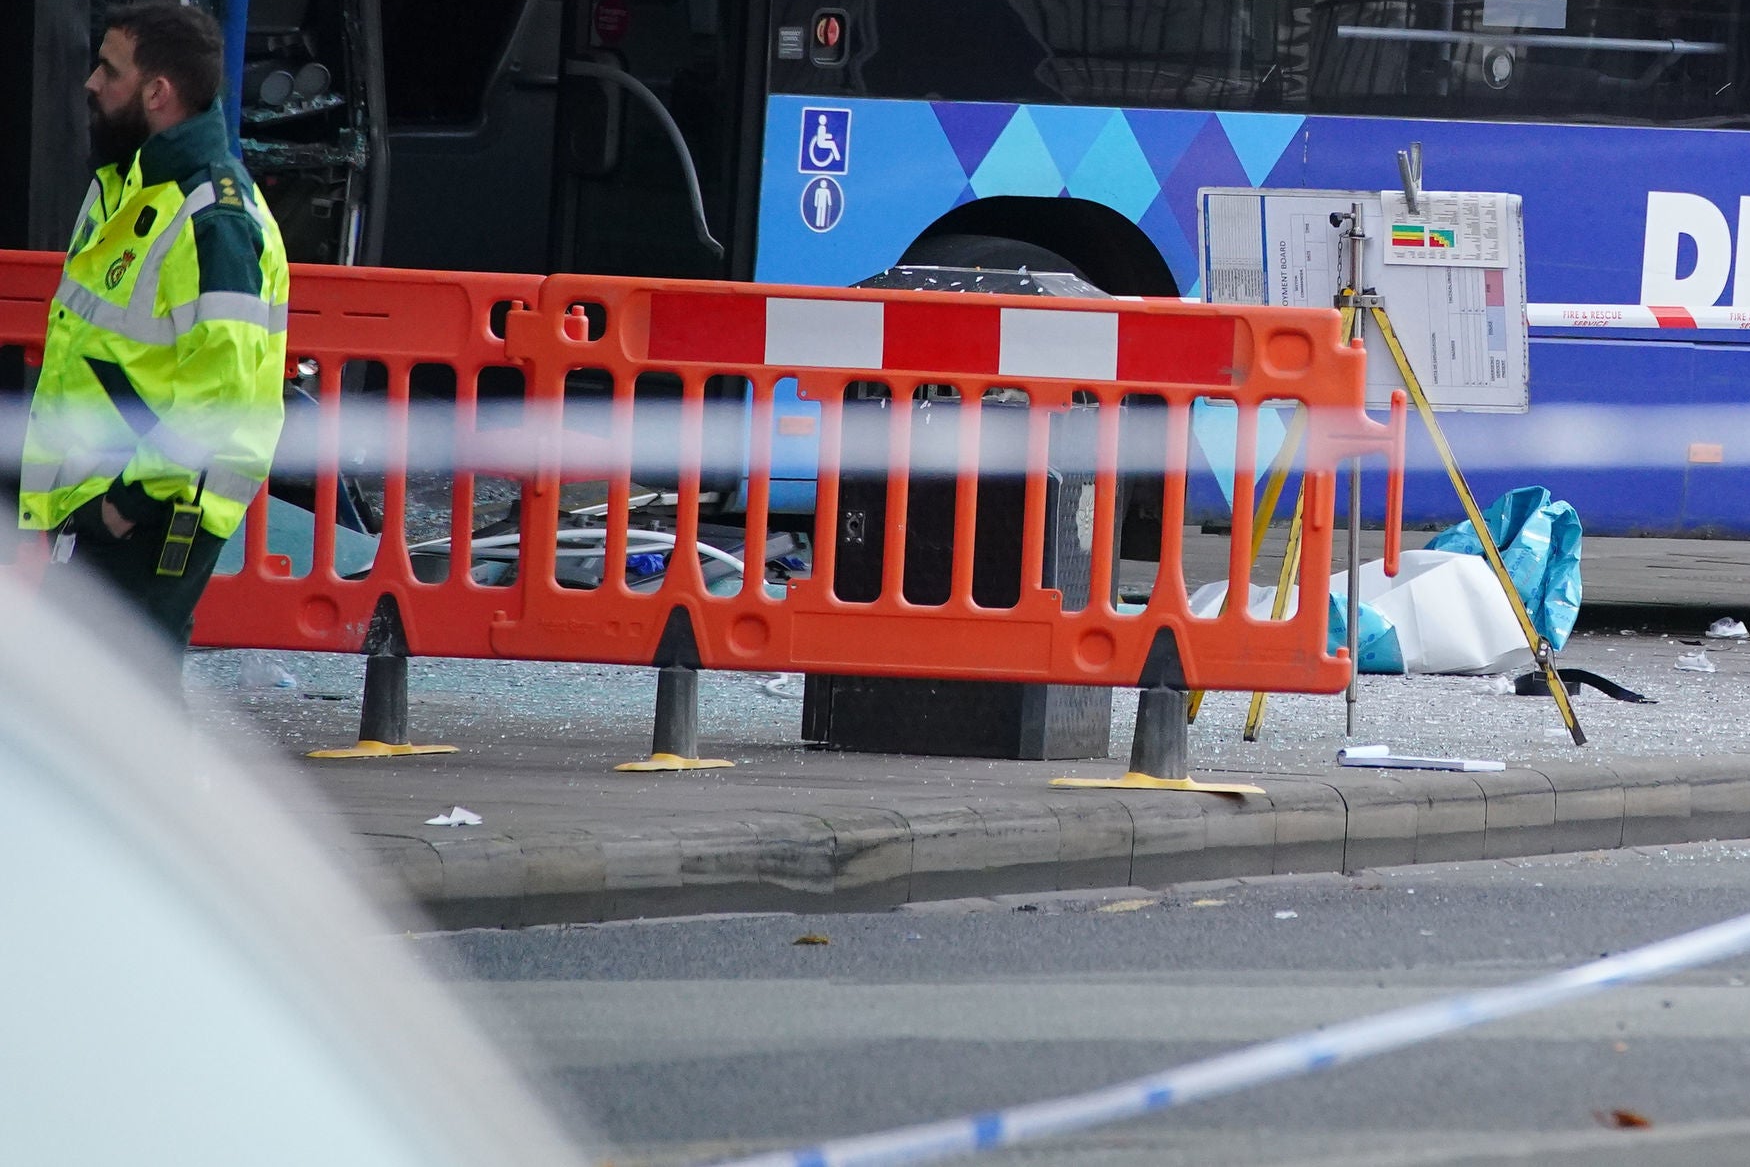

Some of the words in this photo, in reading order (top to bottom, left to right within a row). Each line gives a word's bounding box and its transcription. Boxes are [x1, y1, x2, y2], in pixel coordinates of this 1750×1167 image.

[1279, 240, 1288, 270] BOARD
[1280, 271, 1289, 308] OYMENT
[1563, 311, 1579, 319] FIRE
[1582, 311, 1588, 319] &
[1591, 311, 1623, 319] RESCUE
[1730, 313, 1747, 321] FIRE
